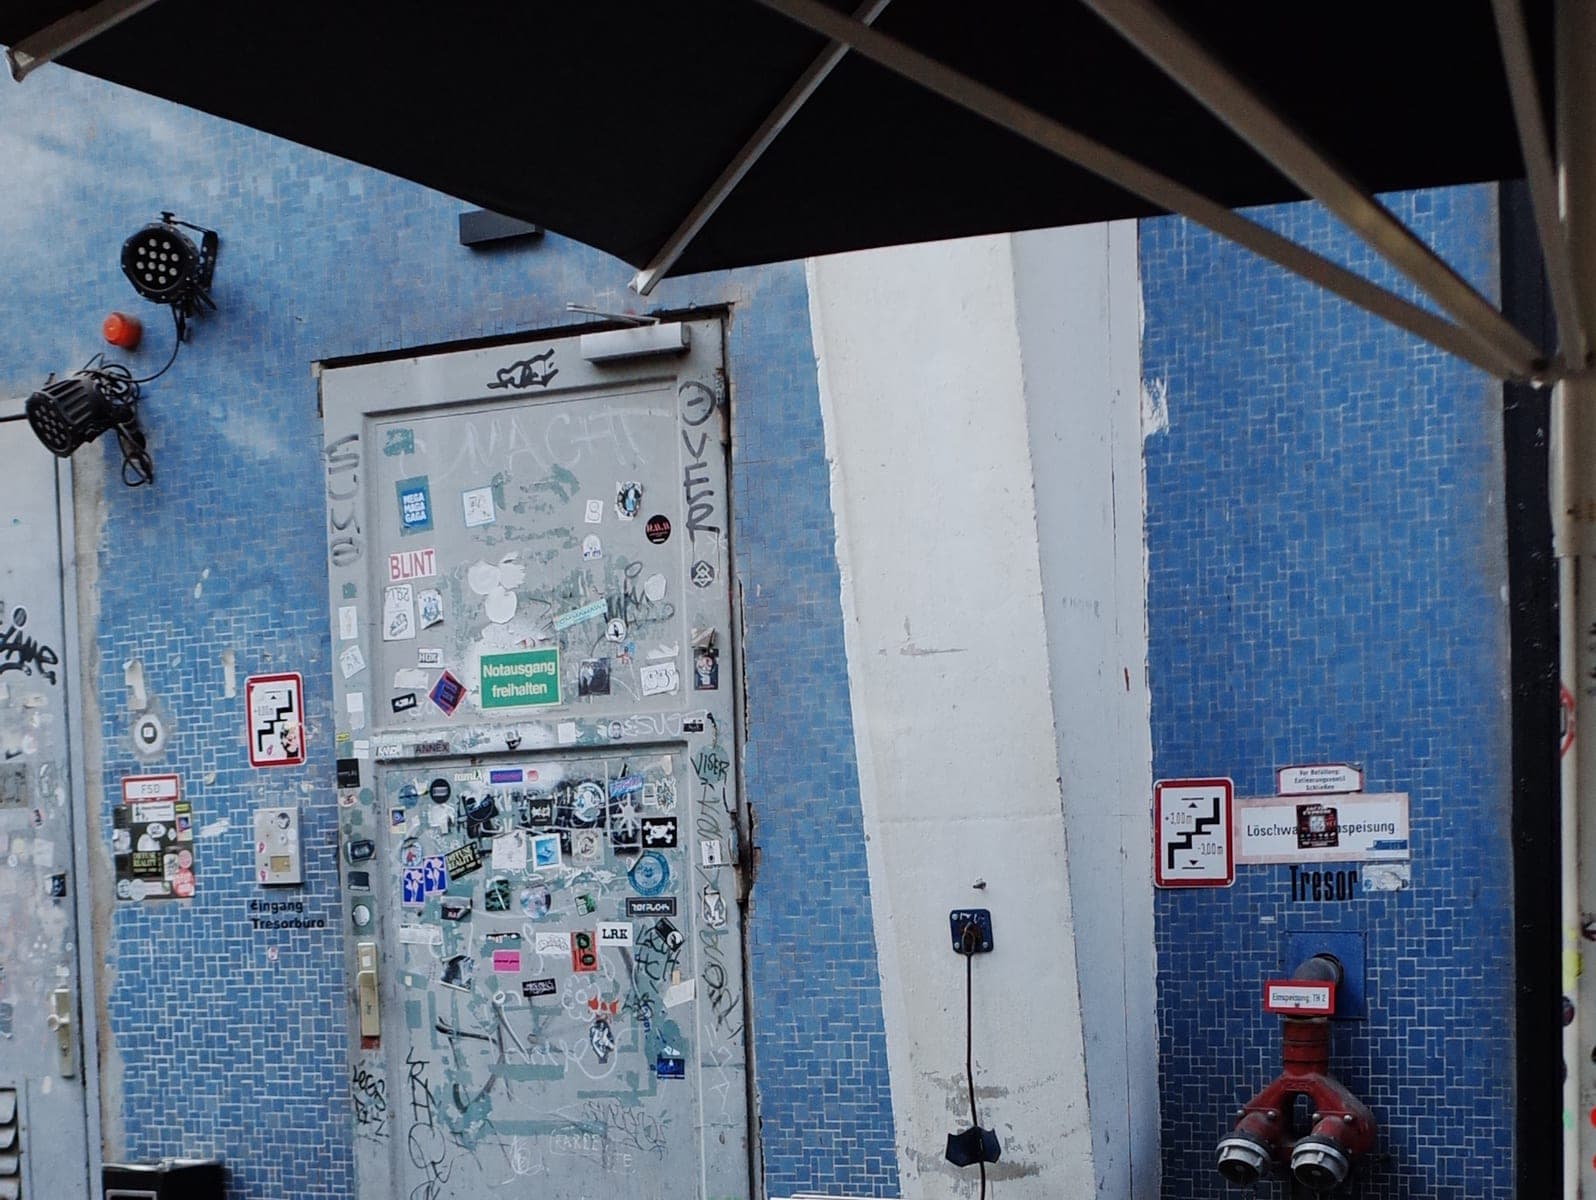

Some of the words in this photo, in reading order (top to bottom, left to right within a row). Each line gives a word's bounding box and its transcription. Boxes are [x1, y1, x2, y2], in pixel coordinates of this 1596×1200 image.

[390, 551, 434, 580] BLINT
[483, 661, 556, 678] Notausgang
[492, 682, 547, 698] freihalten
[1289, 865, 1358, 901] Tresor
[250, 900, 303, 914] Eingang
[251, 917, 325, 930] Tresorbüro
[602, 928, 628, 939] LRK
